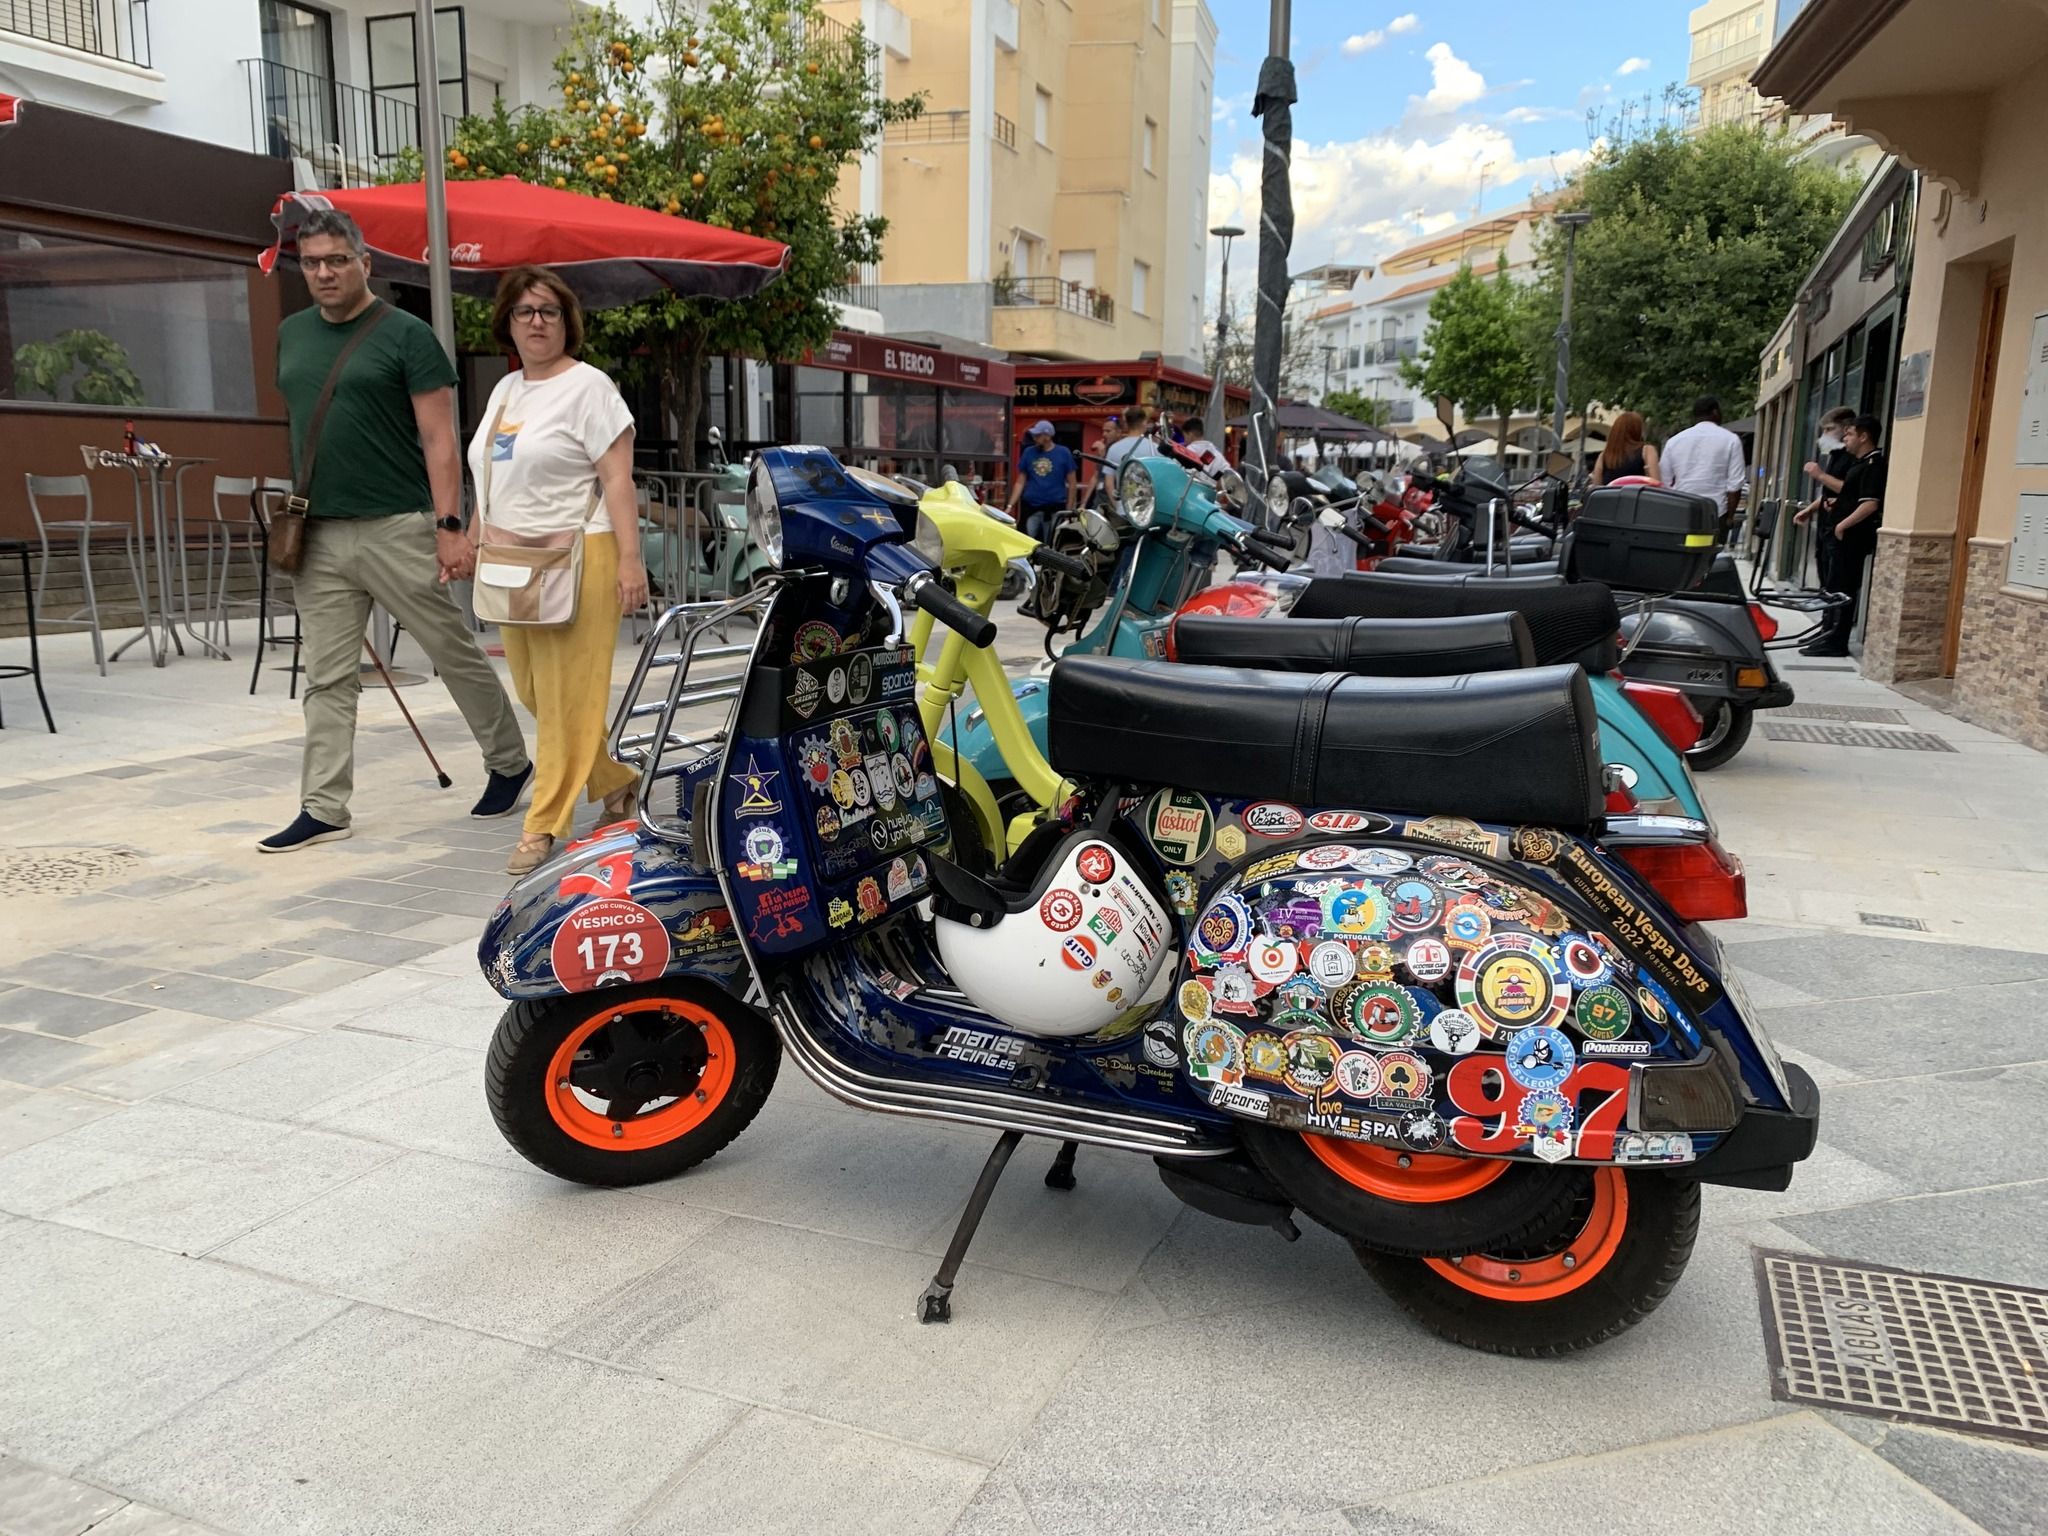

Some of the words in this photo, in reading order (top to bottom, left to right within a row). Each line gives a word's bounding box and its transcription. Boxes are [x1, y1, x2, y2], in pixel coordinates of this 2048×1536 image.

[885, 349, 898, 369] EL
[900, 351, 935, 375] TERCIO
[1013, 384, 1037, 396] RTS
[1043, 383, 1071, 396] BAR
[881, 671, 915, 697] sparco
[1175, 795, 1193, 804] USE
[1158, 806, 1203, 836] Castrol
[1163, 845, 1183, 855] ONLY
[1055, 891, 1074, 900] NEED
[1384, 880, 1401, 896] VESPA
[609, 903, 635, 912] CURVAS
[1130, 883, 1157, 920] Alejandro
[1278, 908, 1293, 919] IV
[572, 912, 645, 930] VESPICOS
[1094, 918, 1114, 942] TAG
[1099, 907, 1122, 934] HEUER
[1568, 845, 1636, 918] European
[1634, 910, 1676, 960] Vespa
[1672, 952, 1710, 993] Days
[1333, 933, 1372, 941] PORTUGAL
[577, 932, 644, 970] 173
[1064, 938, 1093, 968] Gulf
[1611, 915, 1645, 949] 2022
[1644, 949, 1682, 987] PORTUGAL
[1591, 1003, 1617, 1021] 97
[1524, 1078, 1554, 1089] LEON
[1316, 1087, 1343, 1115] love
[1446, 1055, 1631, 1160] 97
[1834, 1298, 1887, 1366] AGUAS
